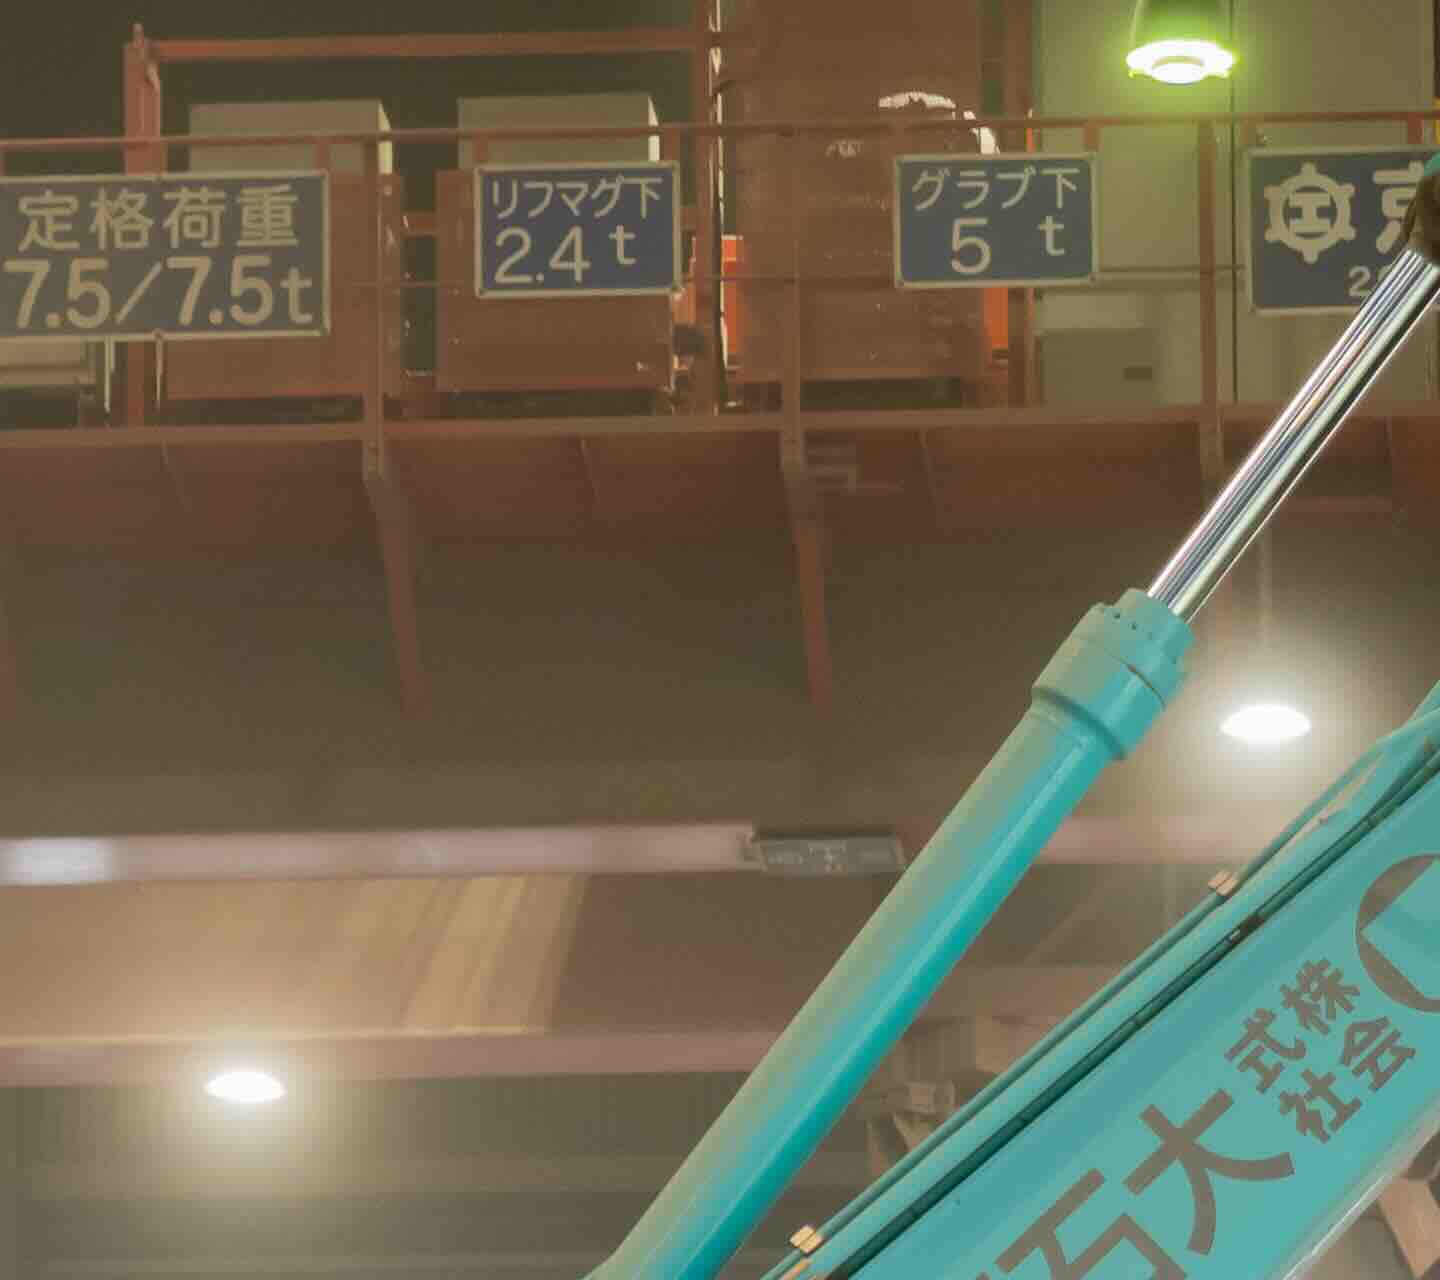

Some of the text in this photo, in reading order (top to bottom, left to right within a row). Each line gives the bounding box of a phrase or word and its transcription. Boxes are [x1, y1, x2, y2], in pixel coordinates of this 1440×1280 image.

[16, 184, 300, 253] 定格荷重
[490, 175, 663, 220] リフマグ下
[910, 167, 1081, 212] グラブ下
[494, 224, 637, 286] 2.4 t
[949, 214, 1066, 275] 5 t
[3, 255, 314, 330] 7.5/7.5t
